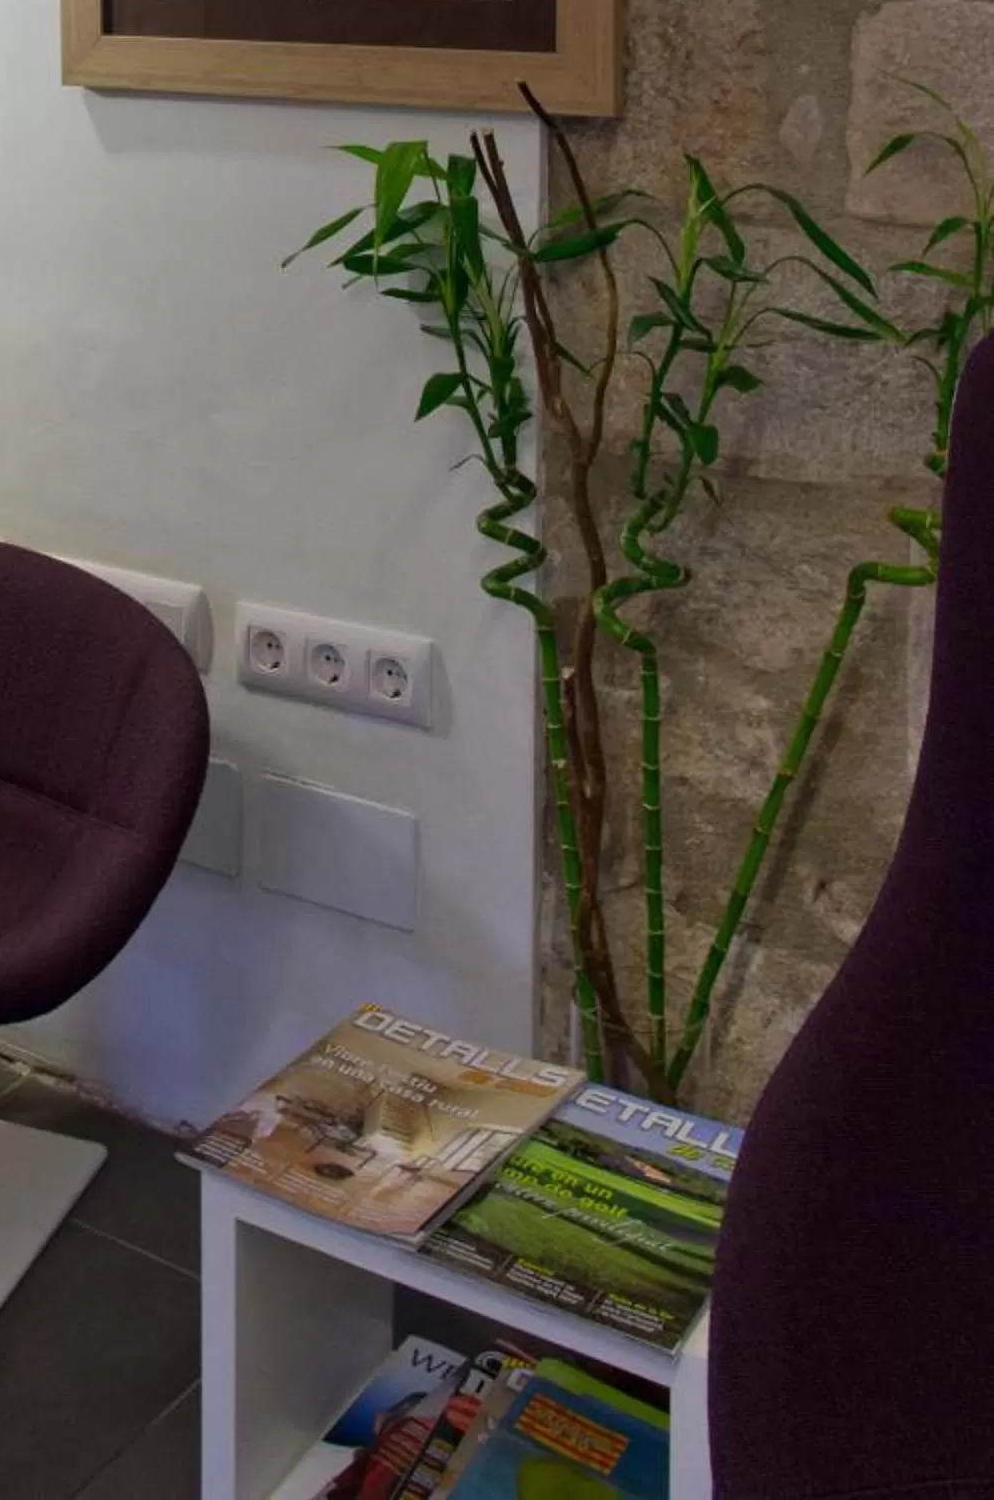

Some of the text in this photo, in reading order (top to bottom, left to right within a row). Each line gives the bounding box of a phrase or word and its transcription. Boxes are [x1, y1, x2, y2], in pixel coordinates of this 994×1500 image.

[352, 1010, 569, 1087] DETALLS
[574, 1088, 739, 1159] ETALL
[577, 1196, 630, 1219] golf
